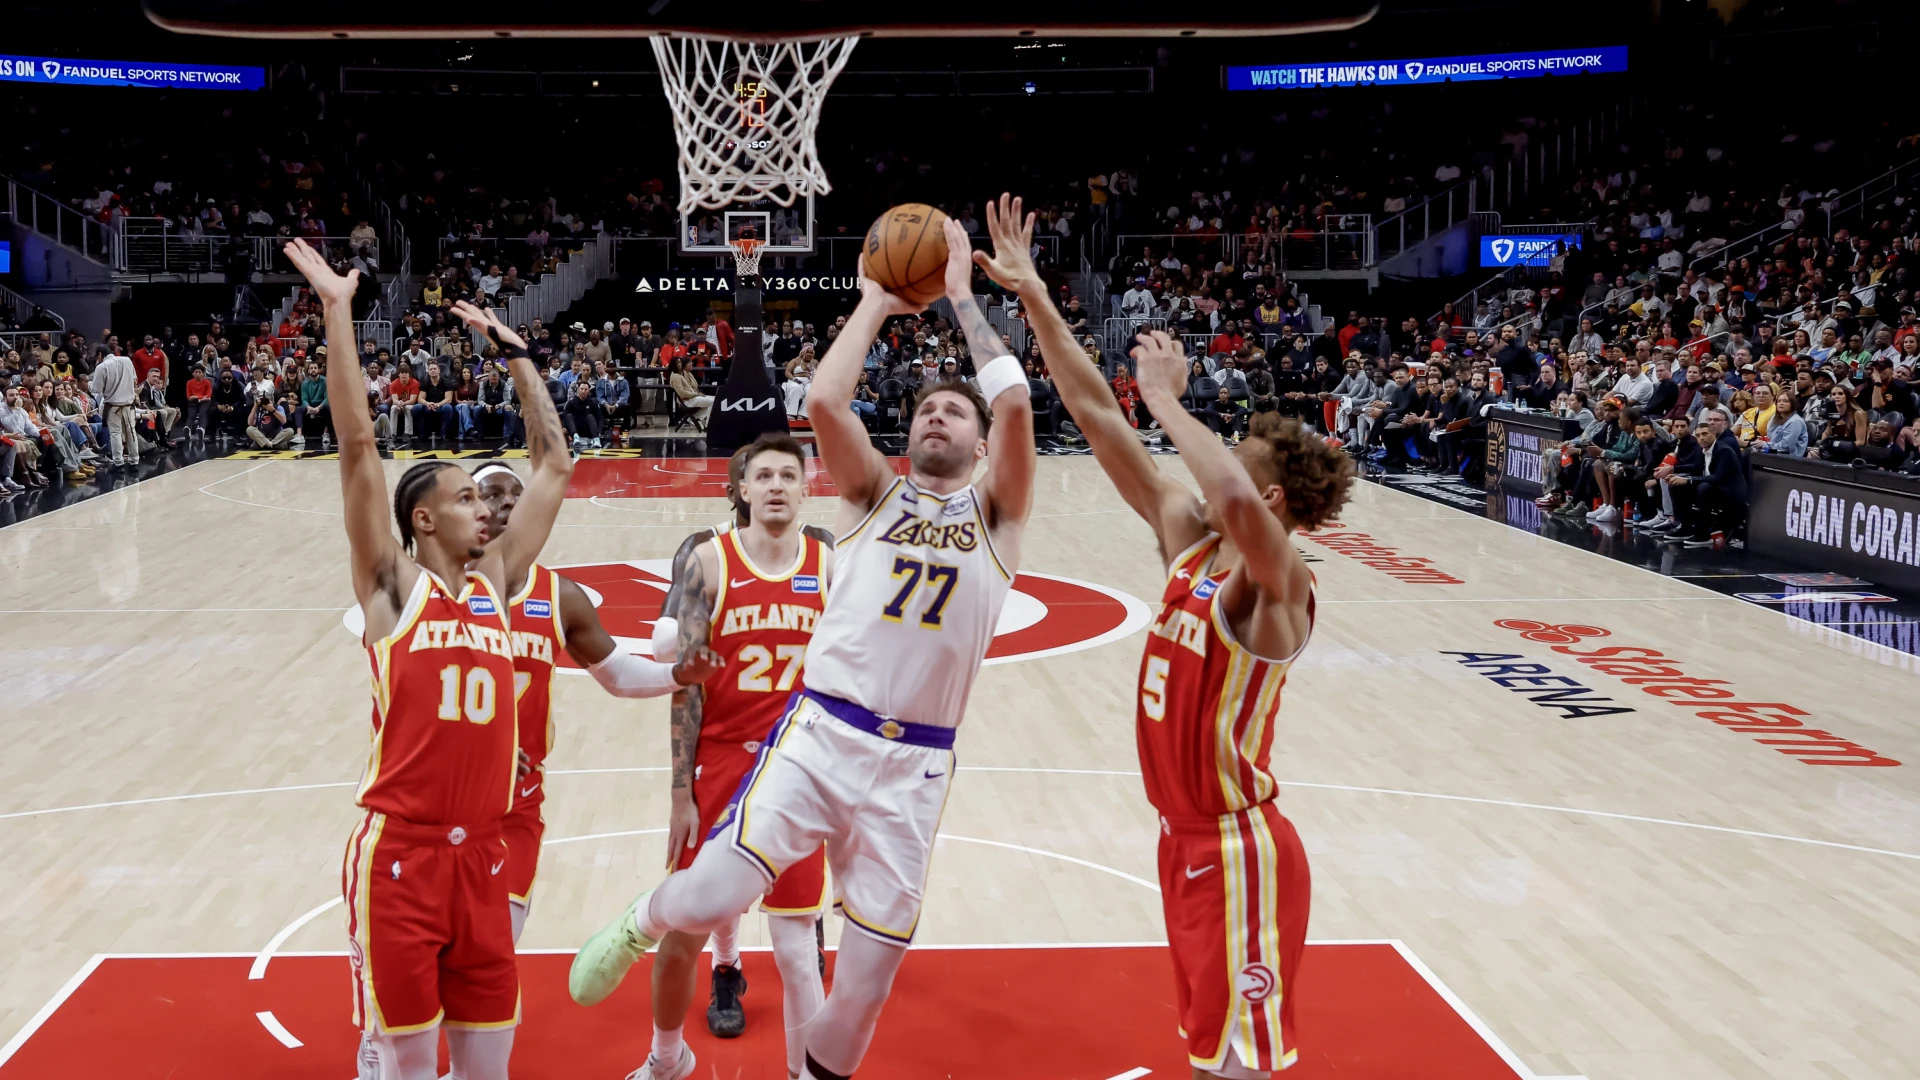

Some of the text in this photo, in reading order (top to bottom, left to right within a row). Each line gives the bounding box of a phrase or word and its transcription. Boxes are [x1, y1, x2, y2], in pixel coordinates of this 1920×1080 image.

[15, 60, 35, 77] ON
[63, 65, 126, 80] FANDUEL
[127, 68, 177, 82] SPORTS
[179, 71, 242, 84] NETWORK
[1250, 54, 1602, 85] WATCH THE HAWKS ON FANDUEL SPORTS NETWORK
[740, 99, 764, 127] 10
[735, 141, 773, 149] TSSO
[659, 277, 730, 291] DELTA
[720, 397, 776, 412] KIA
[1785, 488, 1845, 548] GRAN
[881, 555, 960, 631] 77
[738, 644, 808, 692] 27
[1438, 650, 1637, 719] ARENA
[438, 664, 496, 725] 10
[1141, 654, 1170, 722] 5
